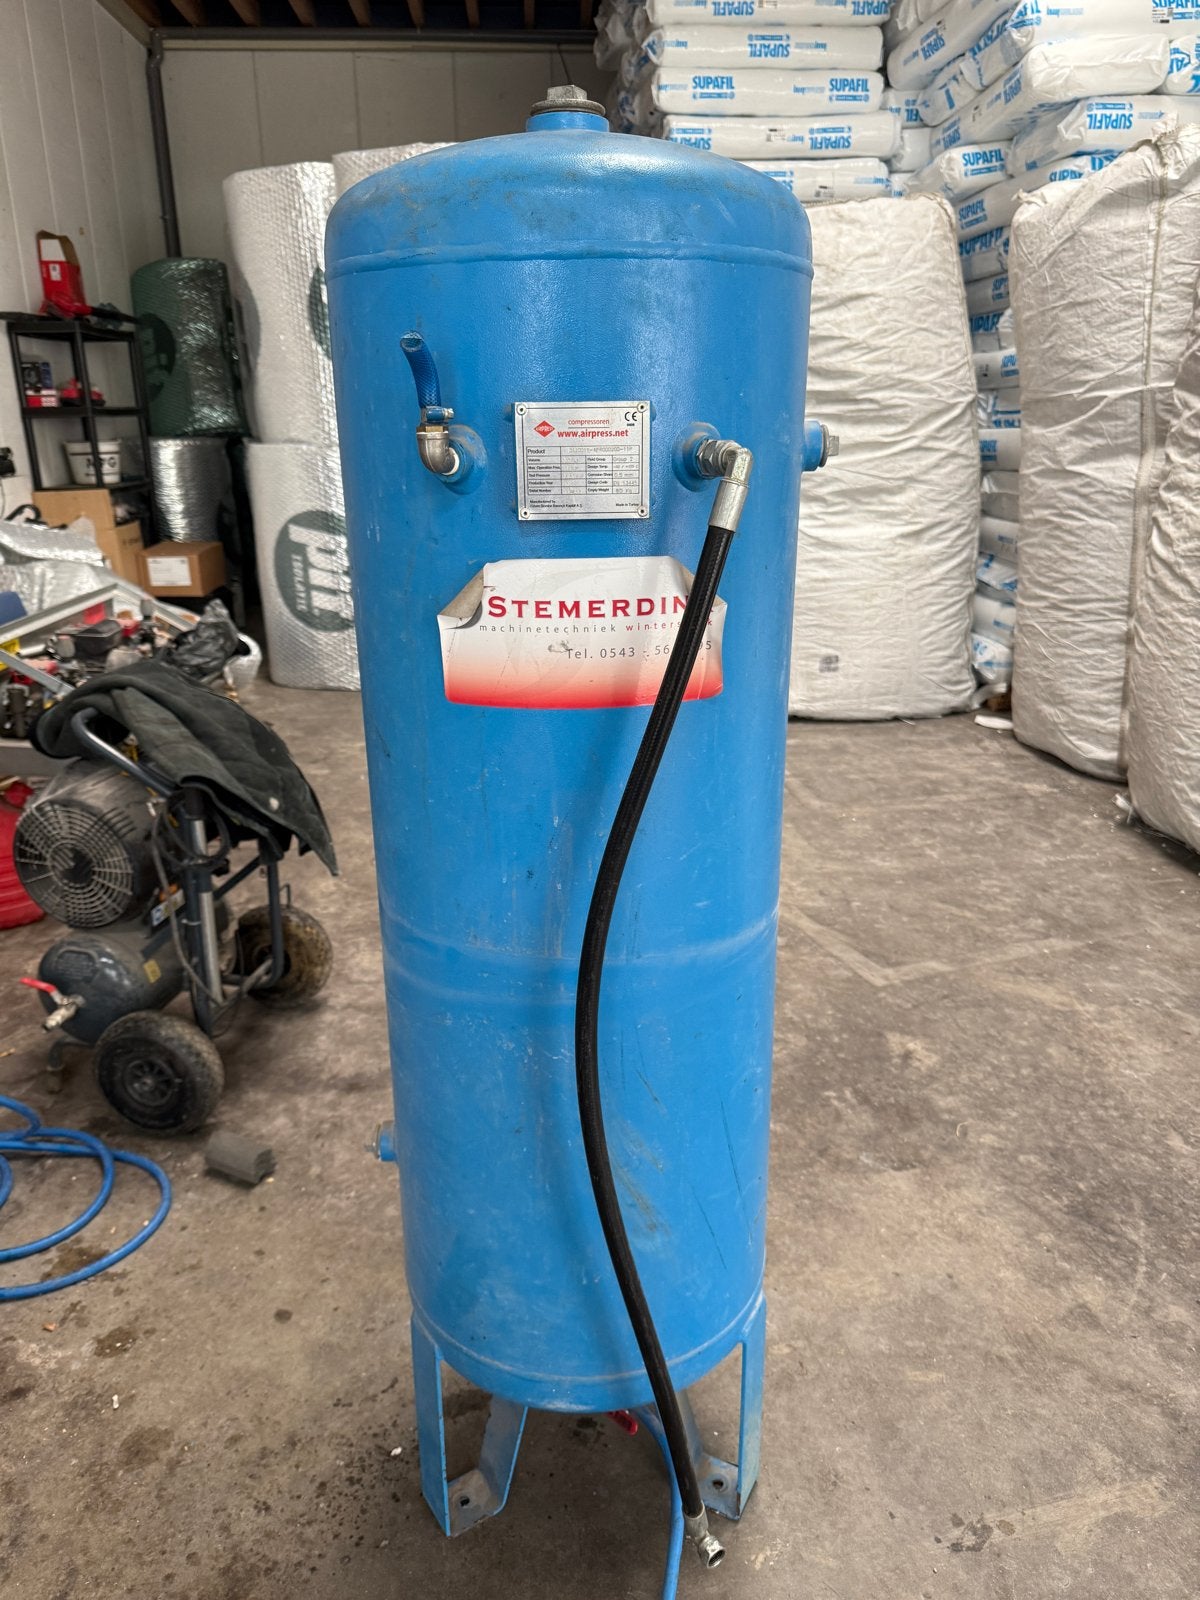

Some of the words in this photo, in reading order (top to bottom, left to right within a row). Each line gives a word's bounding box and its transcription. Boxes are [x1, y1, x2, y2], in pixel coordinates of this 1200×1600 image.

[712, 1, 755, 16] SUPAFIL
[748, 42, 790, 58] SUPAFIL
[692, 75, 735, 90] SUPAFIL
[829, 77, 870, 92] SUPAFIL
[1086, 112, 1134, 131] SUPAFIL
[808, 135, 852, 150] SUPAFIL
[961, 148, 1005, 167] SUPAFIL
[958, 198, 987, 222] SUPAFIL
[568, 417, 610, 426] compressoren
[557, 428, 629, 439] www.airpress.net
[487, 594, 714, 621] STEMERDIN
[479, 624, 617, 634] machinetechniek
[566, 647, 593, 659] Tel.
[600, 646, 636, 659] 0543
